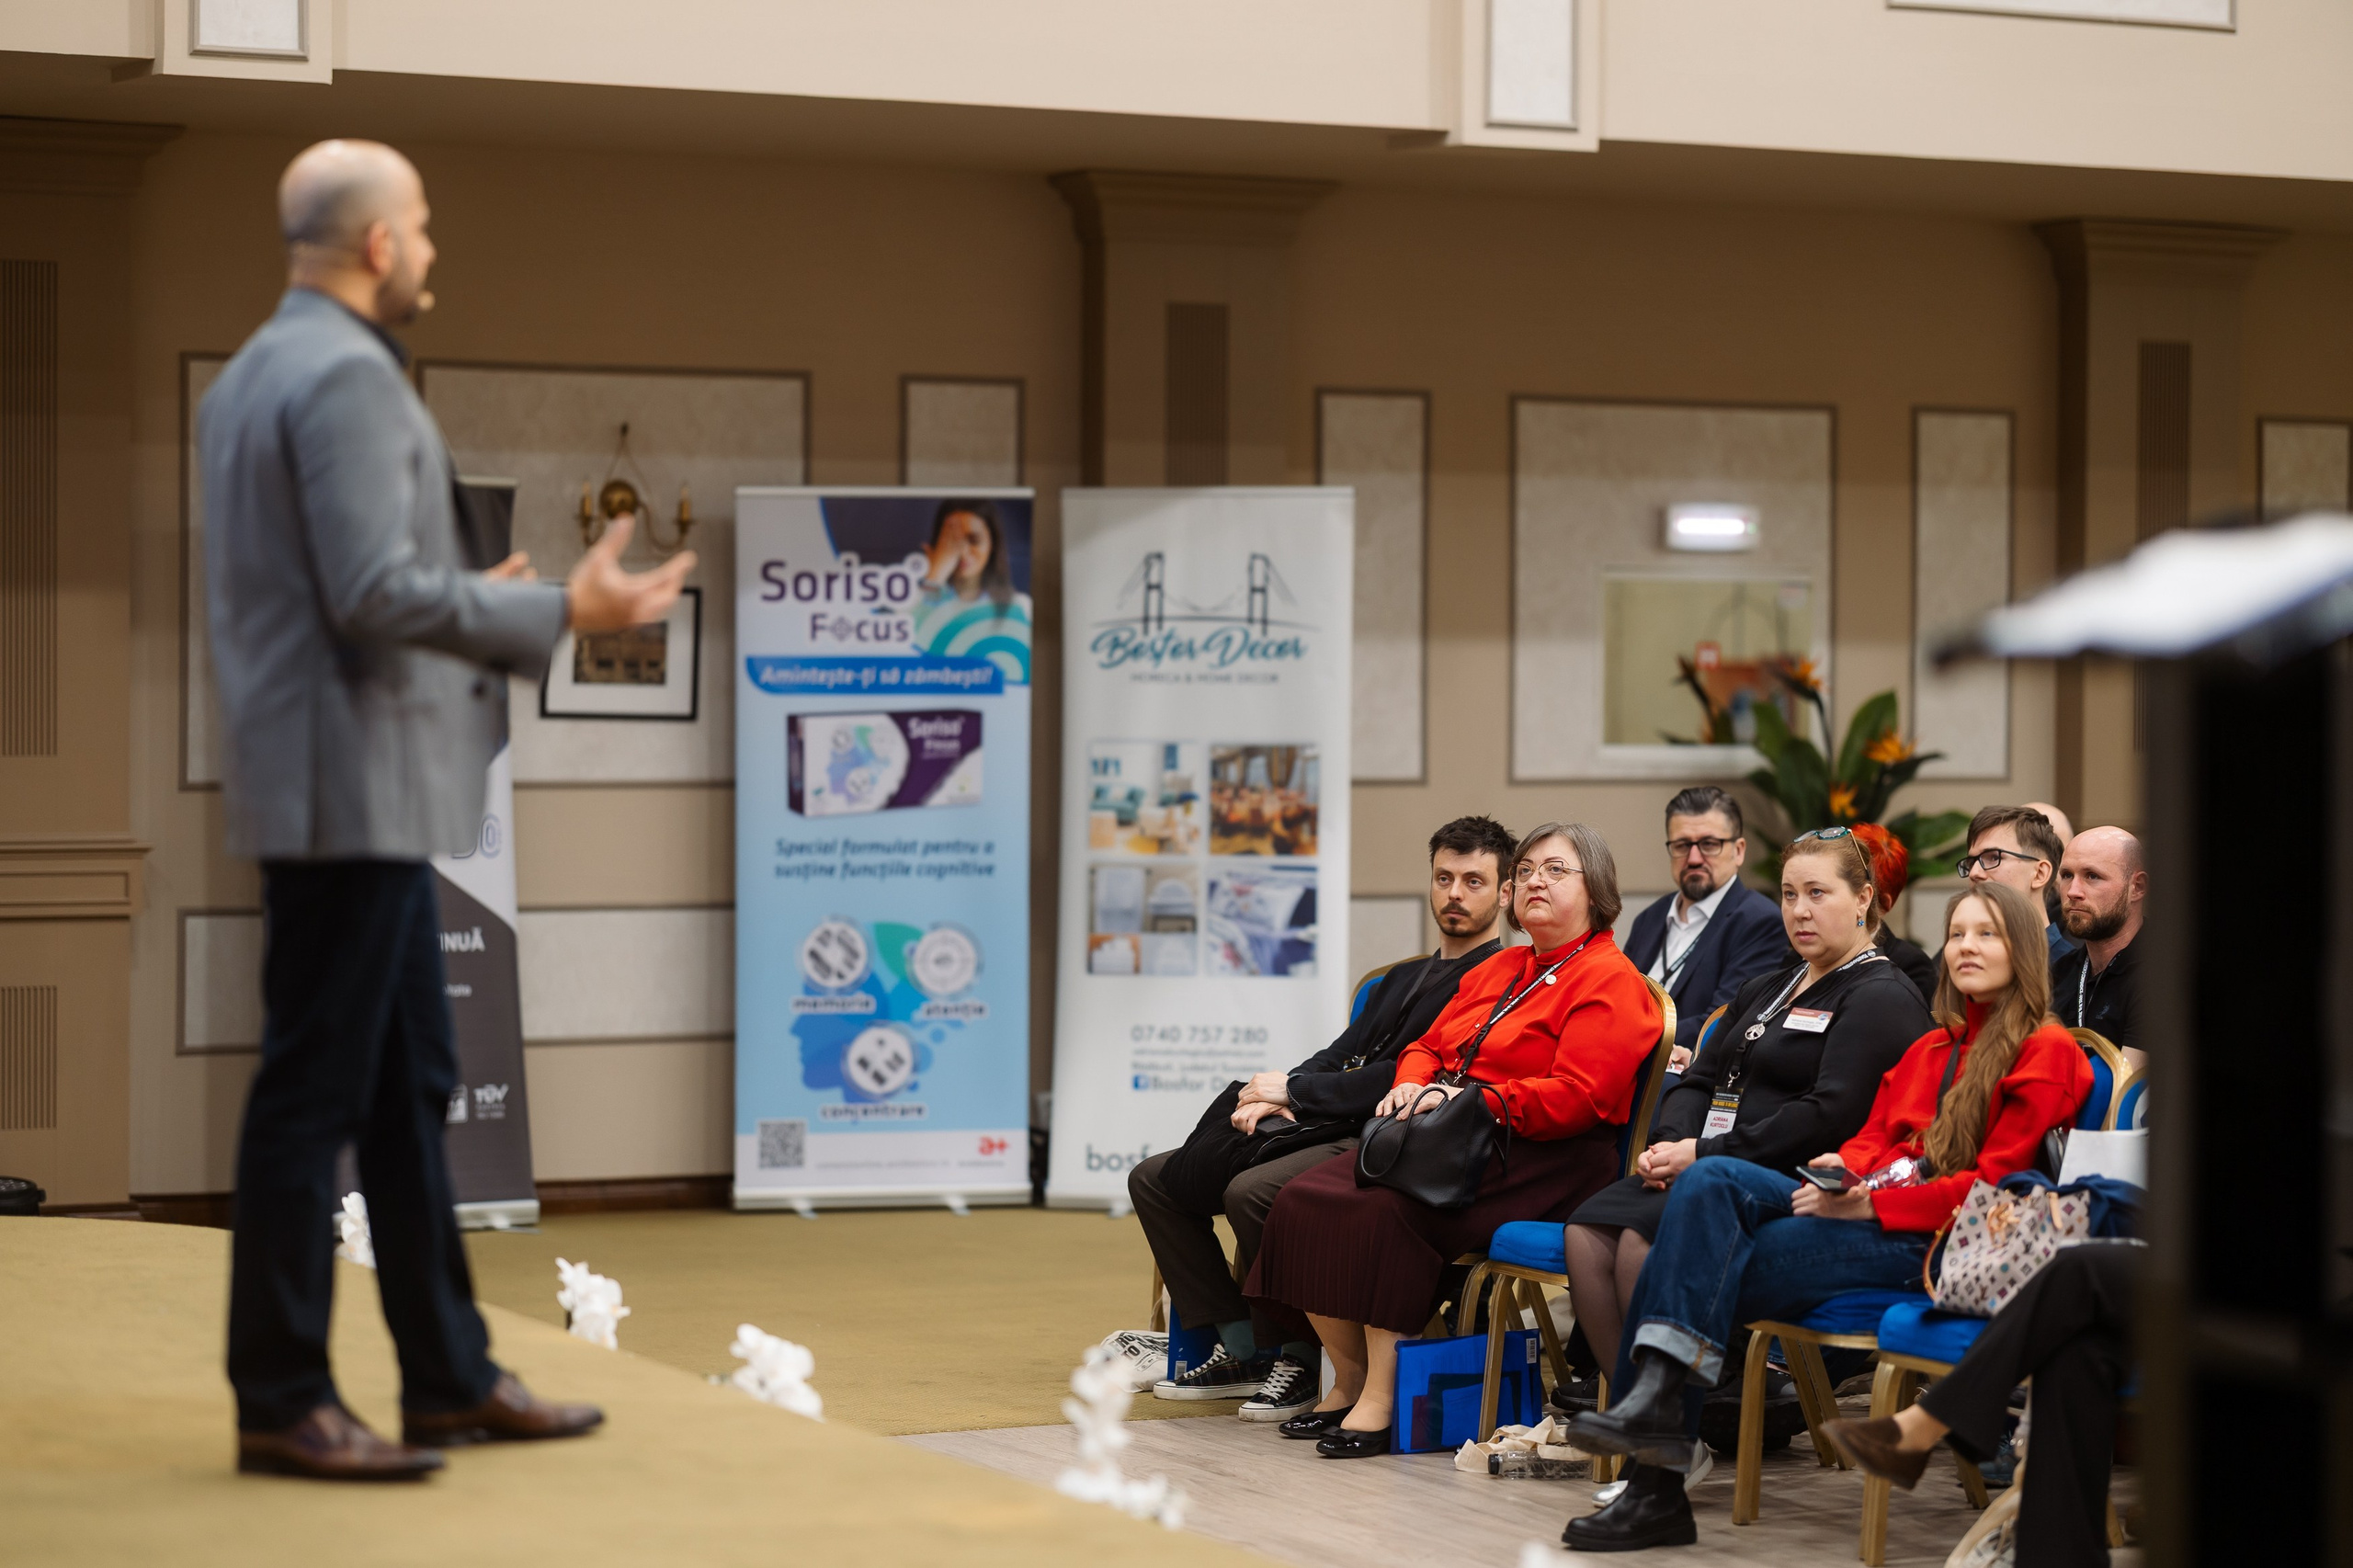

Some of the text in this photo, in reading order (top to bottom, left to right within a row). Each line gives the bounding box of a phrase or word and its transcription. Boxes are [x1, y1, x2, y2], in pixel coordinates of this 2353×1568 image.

[810, 613, 910, 642] Focus
[775, 837, 837, 857] Special
[839, 837, 918, 857] formulat
[920, 840, 979, 858] pentru
[915, 861, 995, 882] cognitive
[438, 926, 486, 952] INUĂ
[793, 996, 870, 1009] memorie
[1131, 1025, 1269, 1045] 0740 757 280
[820, 1105, 925, 1118] concentrare
